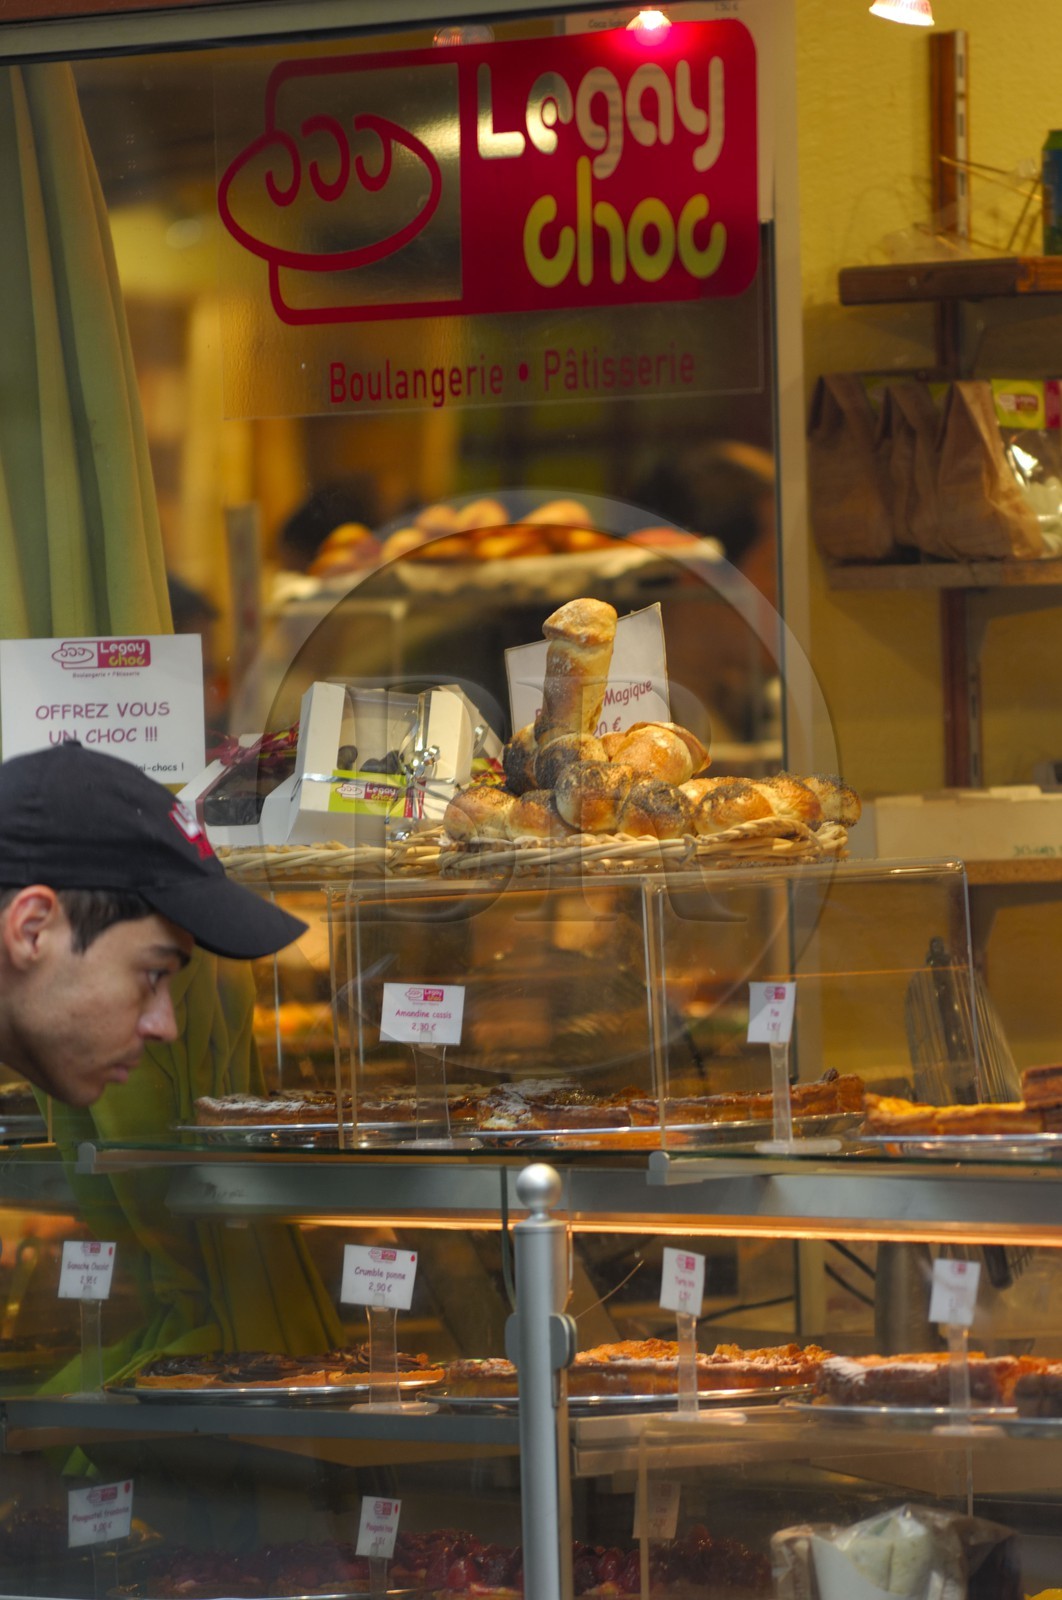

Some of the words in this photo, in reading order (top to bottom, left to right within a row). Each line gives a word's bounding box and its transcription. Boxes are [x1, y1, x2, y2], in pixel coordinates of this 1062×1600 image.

[477, 56, 724, 179] Legay
[523, 155, 726, 287] choc
[329, 354, 504, 408] Boulangerie
[544, 341, 696, 392] Pâtisserie
[100, 640, 145, 655] Legay
[108, 653, 146, 667] choc
[603, 680, 653, 706] Magique
[36, 703, 109, 720] OFFREZ
[116, 702, 171, 718] VOUS
[612, 716, 622, 732] €
[86, 728, 137, 743] CHOC
[144, 726, 158, 742] !!!
[366, 786, 396, 795] Legay
[395, 1009, 430, 1018] Amandine
[432, 1011, 452, 1019] cassis
[354, 1266, 384, 1278] Crumble
